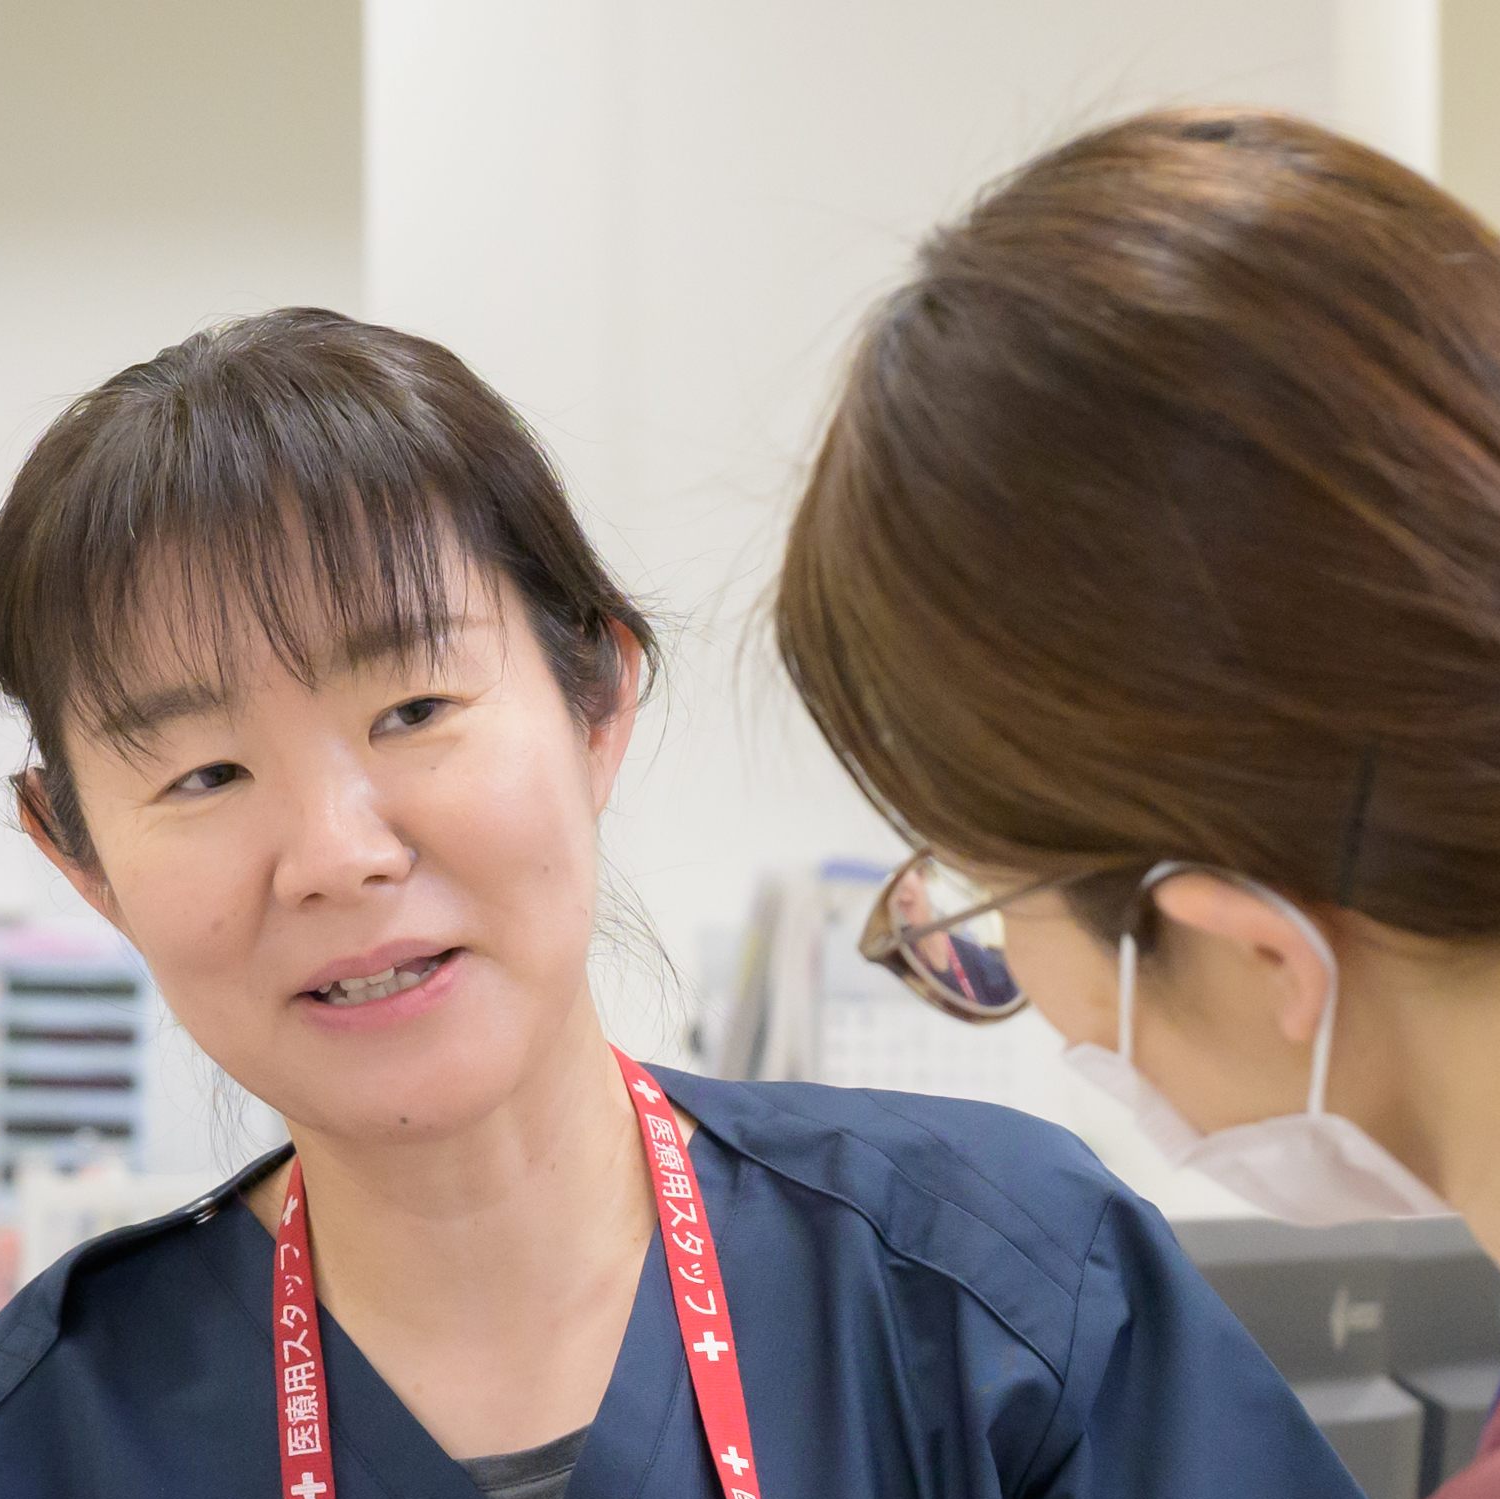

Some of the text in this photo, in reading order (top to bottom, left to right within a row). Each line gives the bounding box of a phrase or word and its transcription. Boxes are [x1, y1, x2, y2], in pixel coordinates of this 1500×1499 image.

[644, 1113, 719, 1316] 医療用スタッフ
[280, 1241, 323, 1457] 医療用スタッフ
